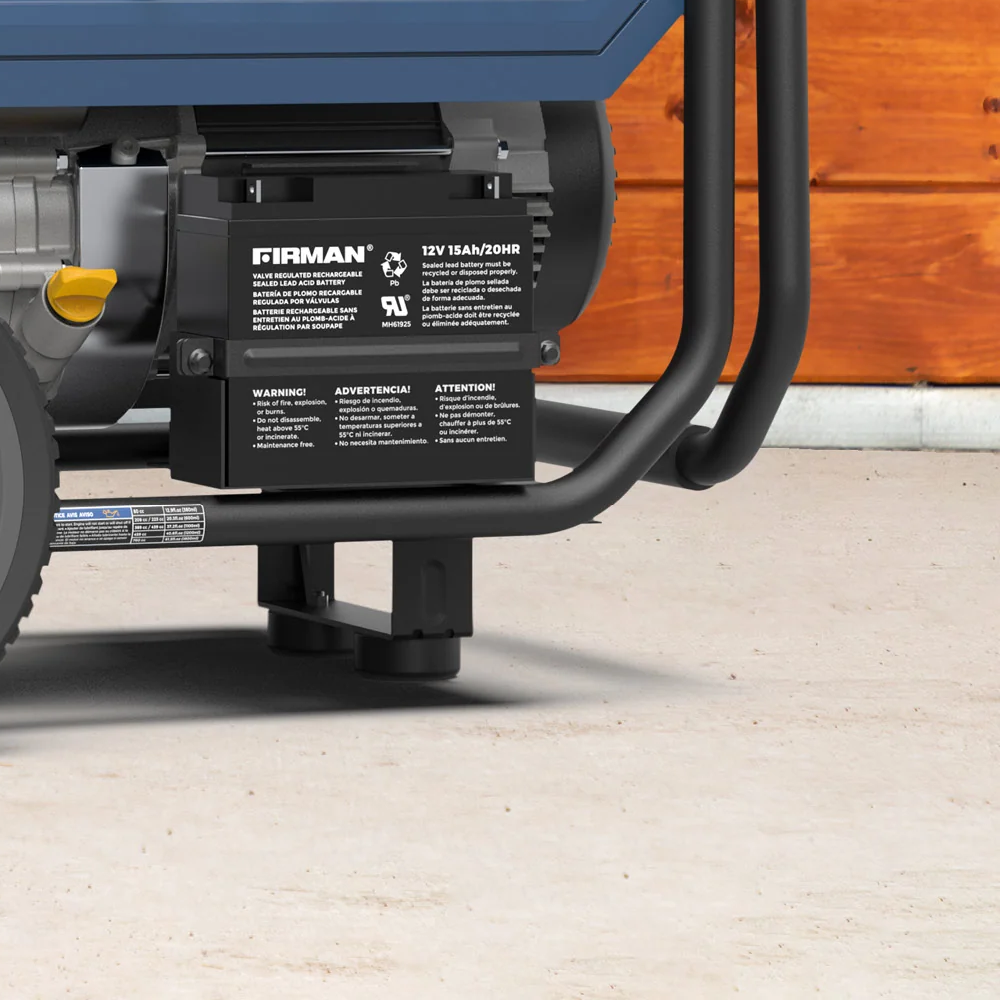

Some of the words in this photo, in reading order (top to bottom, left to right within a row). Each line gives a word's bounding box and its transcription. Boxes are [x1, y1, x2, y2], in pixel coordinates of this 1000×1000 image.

[422, 246, 445, 256] 12V
[448, 244, 520, 256] 15Ah/20HR
[253, 388, 306, 397] WARNING!
[335, 386, 410, 396] ADVERTENCIA!
[435, 383, 496, 393] ATTENTION!
